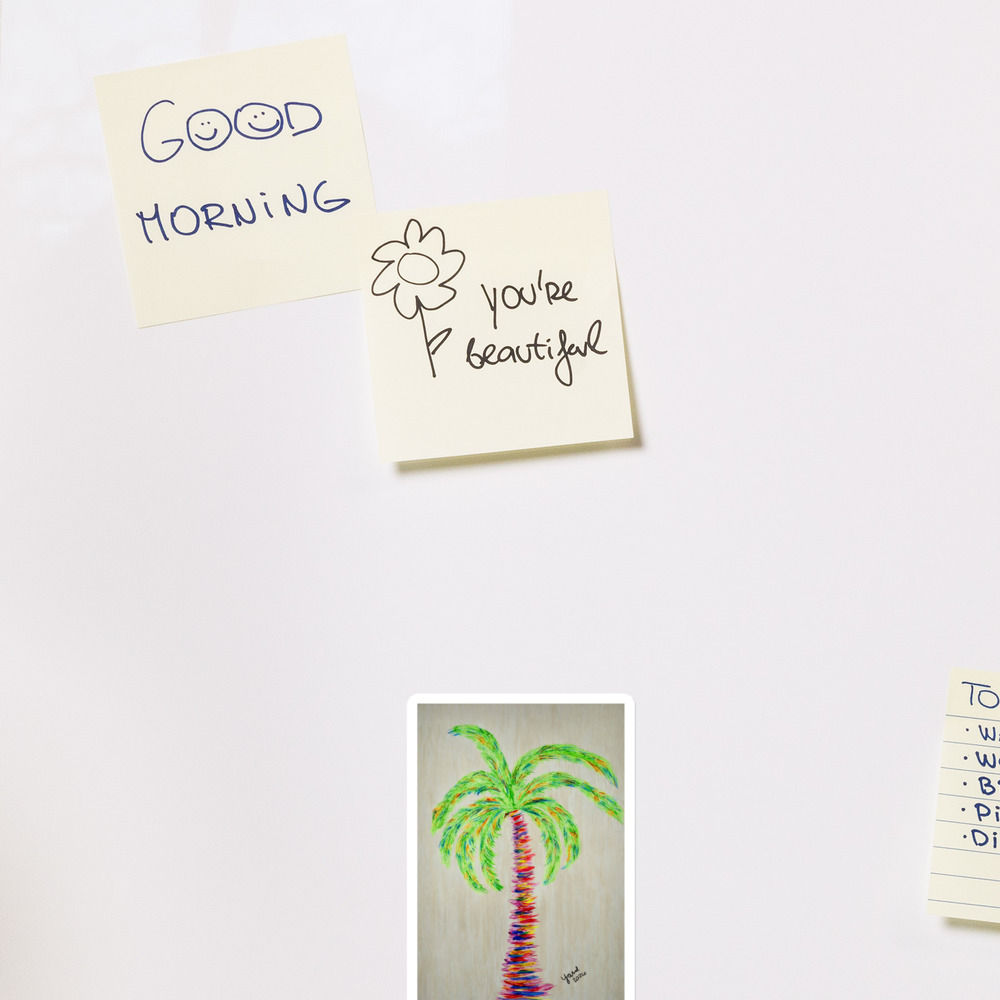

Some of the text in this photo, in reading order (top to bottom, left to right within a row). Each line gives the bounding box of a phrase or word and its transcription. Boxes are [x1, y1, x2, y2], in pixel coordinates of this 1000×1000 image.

[141, 100, 322, 163] GOOD
[481, 270, 578, 329] you're
[466, 320, 607, 386] beautiful
[962, 681, 1000, 710] TO
